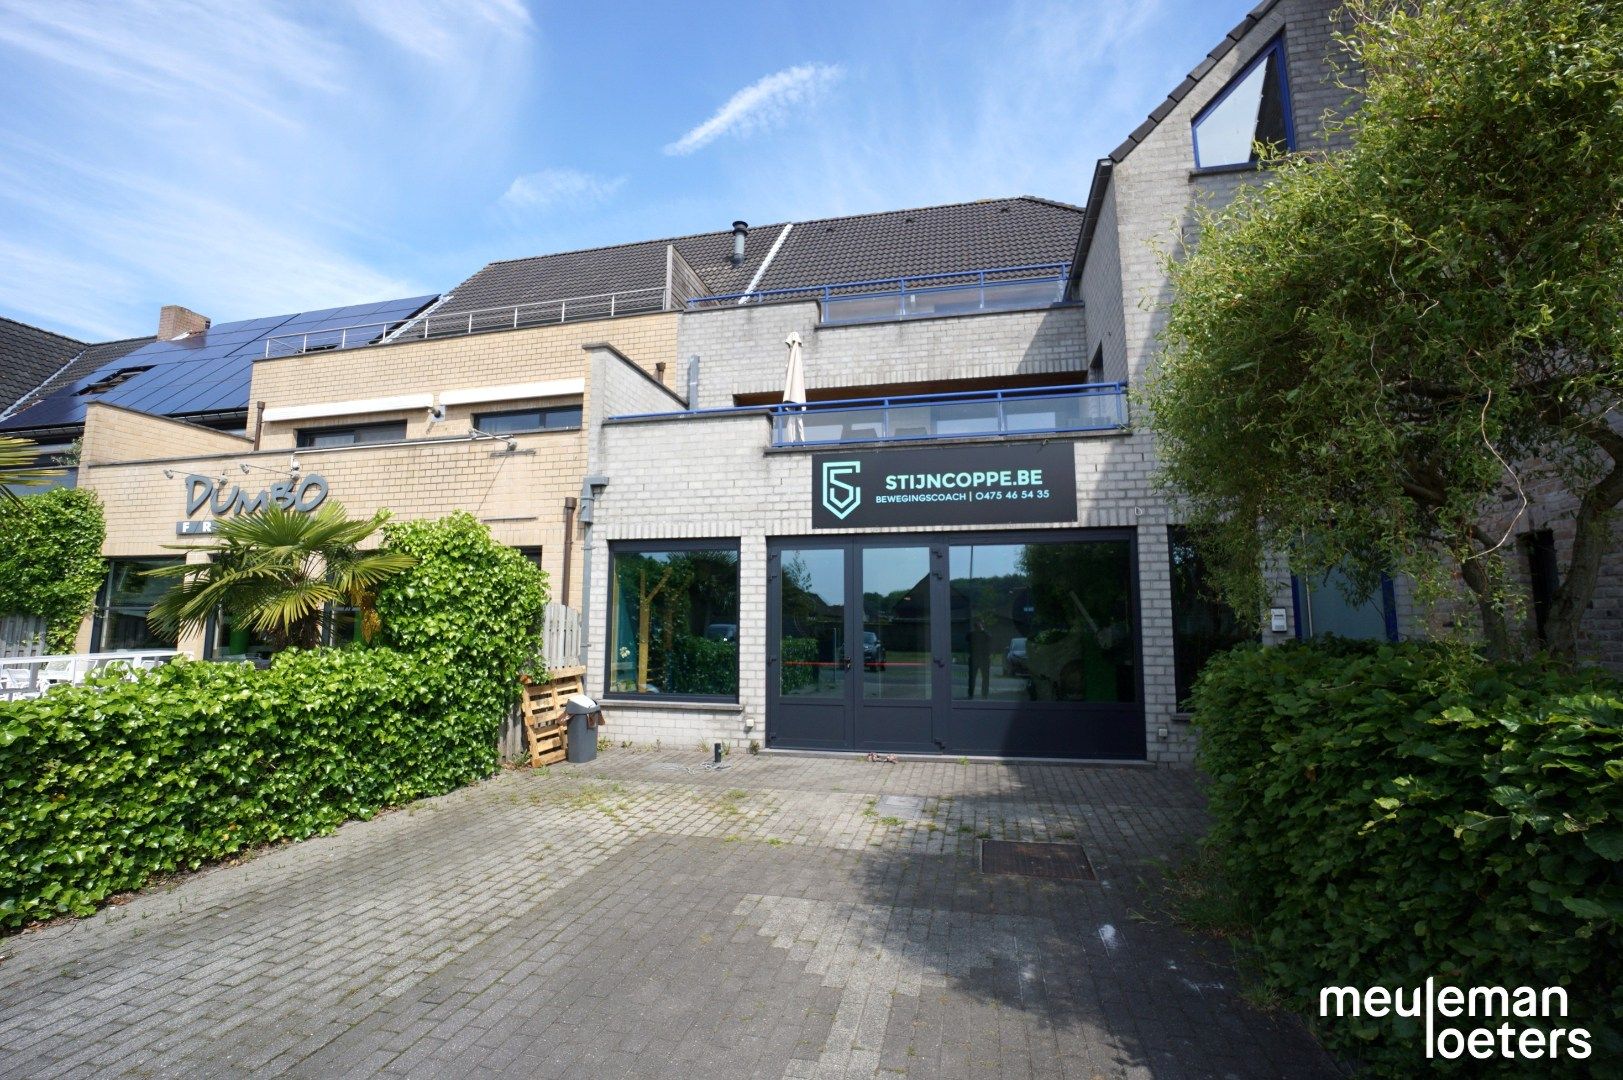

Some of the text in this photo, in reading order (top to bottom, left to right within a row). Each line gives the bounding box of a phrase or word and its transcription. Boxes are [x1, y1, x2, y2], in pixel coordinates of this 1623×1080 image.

[885, 470, 1043, 491] STIJNCOPPE.BE
[184, 473, 329, 517] DUMBO
[875, 489, 1050, 504] BEWEGINGSCOACH 0475 46 54 35
